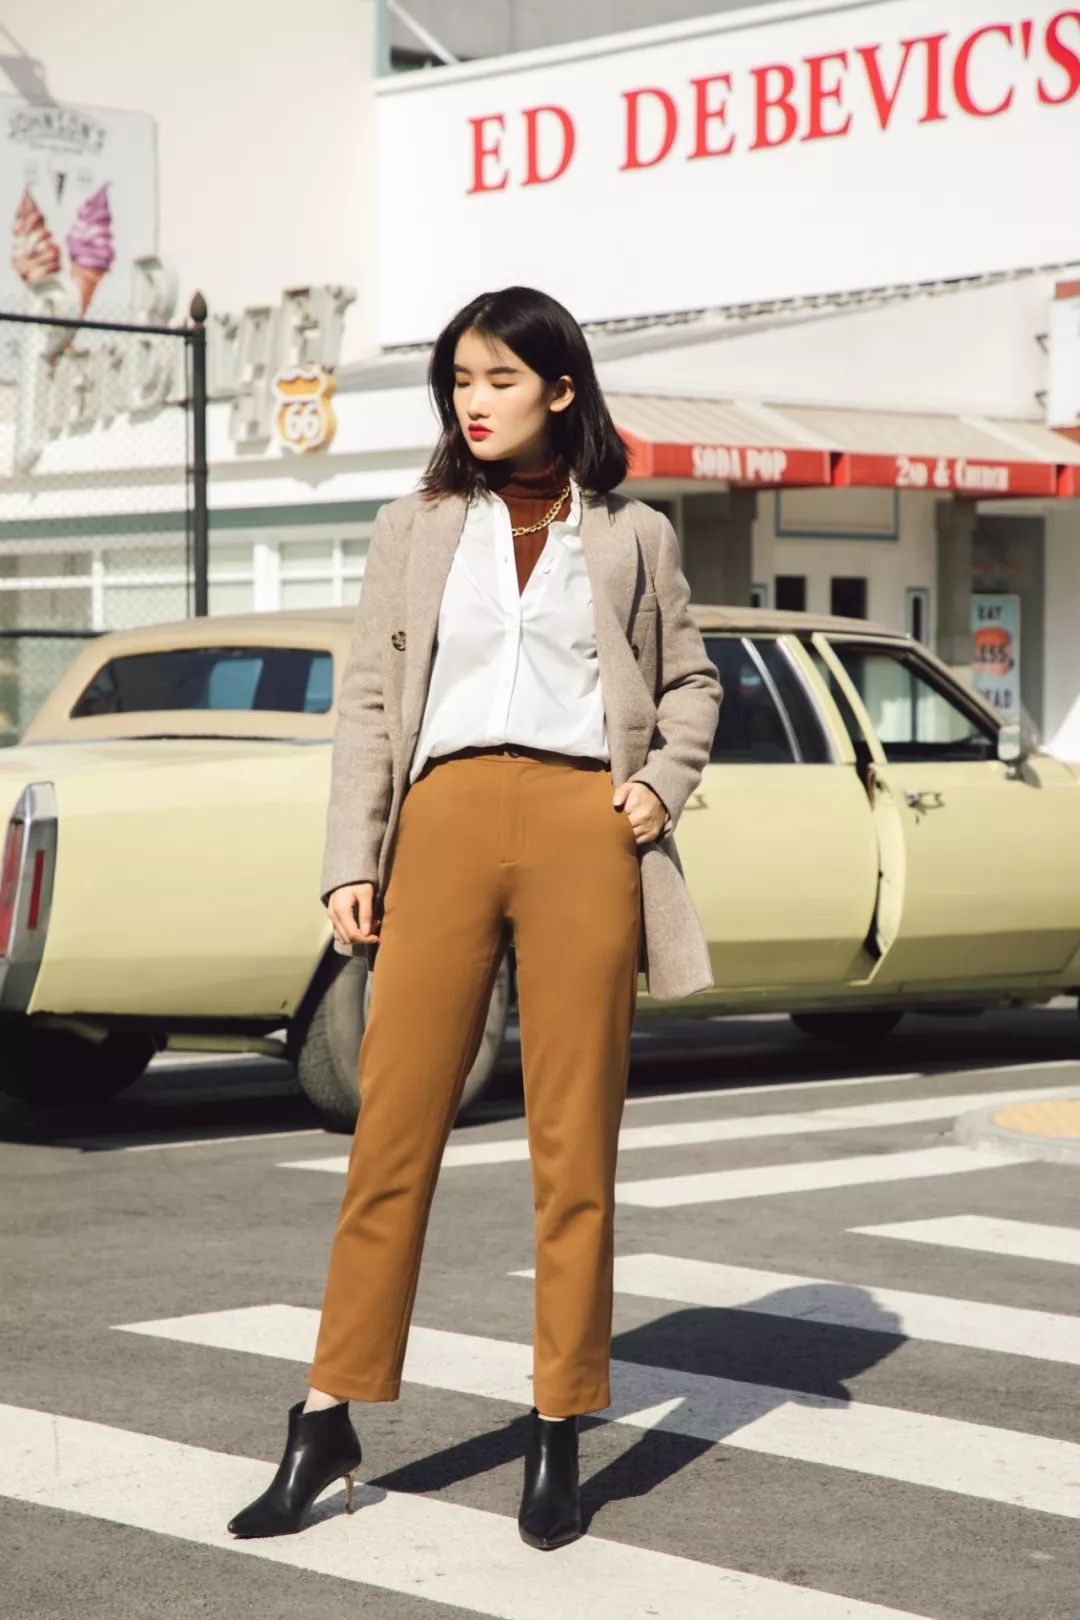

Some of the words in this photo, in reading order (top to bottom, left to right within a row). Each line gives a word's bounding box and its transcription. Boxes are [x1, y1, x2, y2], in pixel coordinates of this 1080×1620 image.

[468, 105, 578, 194] ED
[621, 9, 1080, 171] DEBEVIC'S
[286, 403, 320, 440] 66
[692, 446, 741, 479] SODA
[746, 447, 787, 482] POP
[978, 605, 1002, 621] EAT
